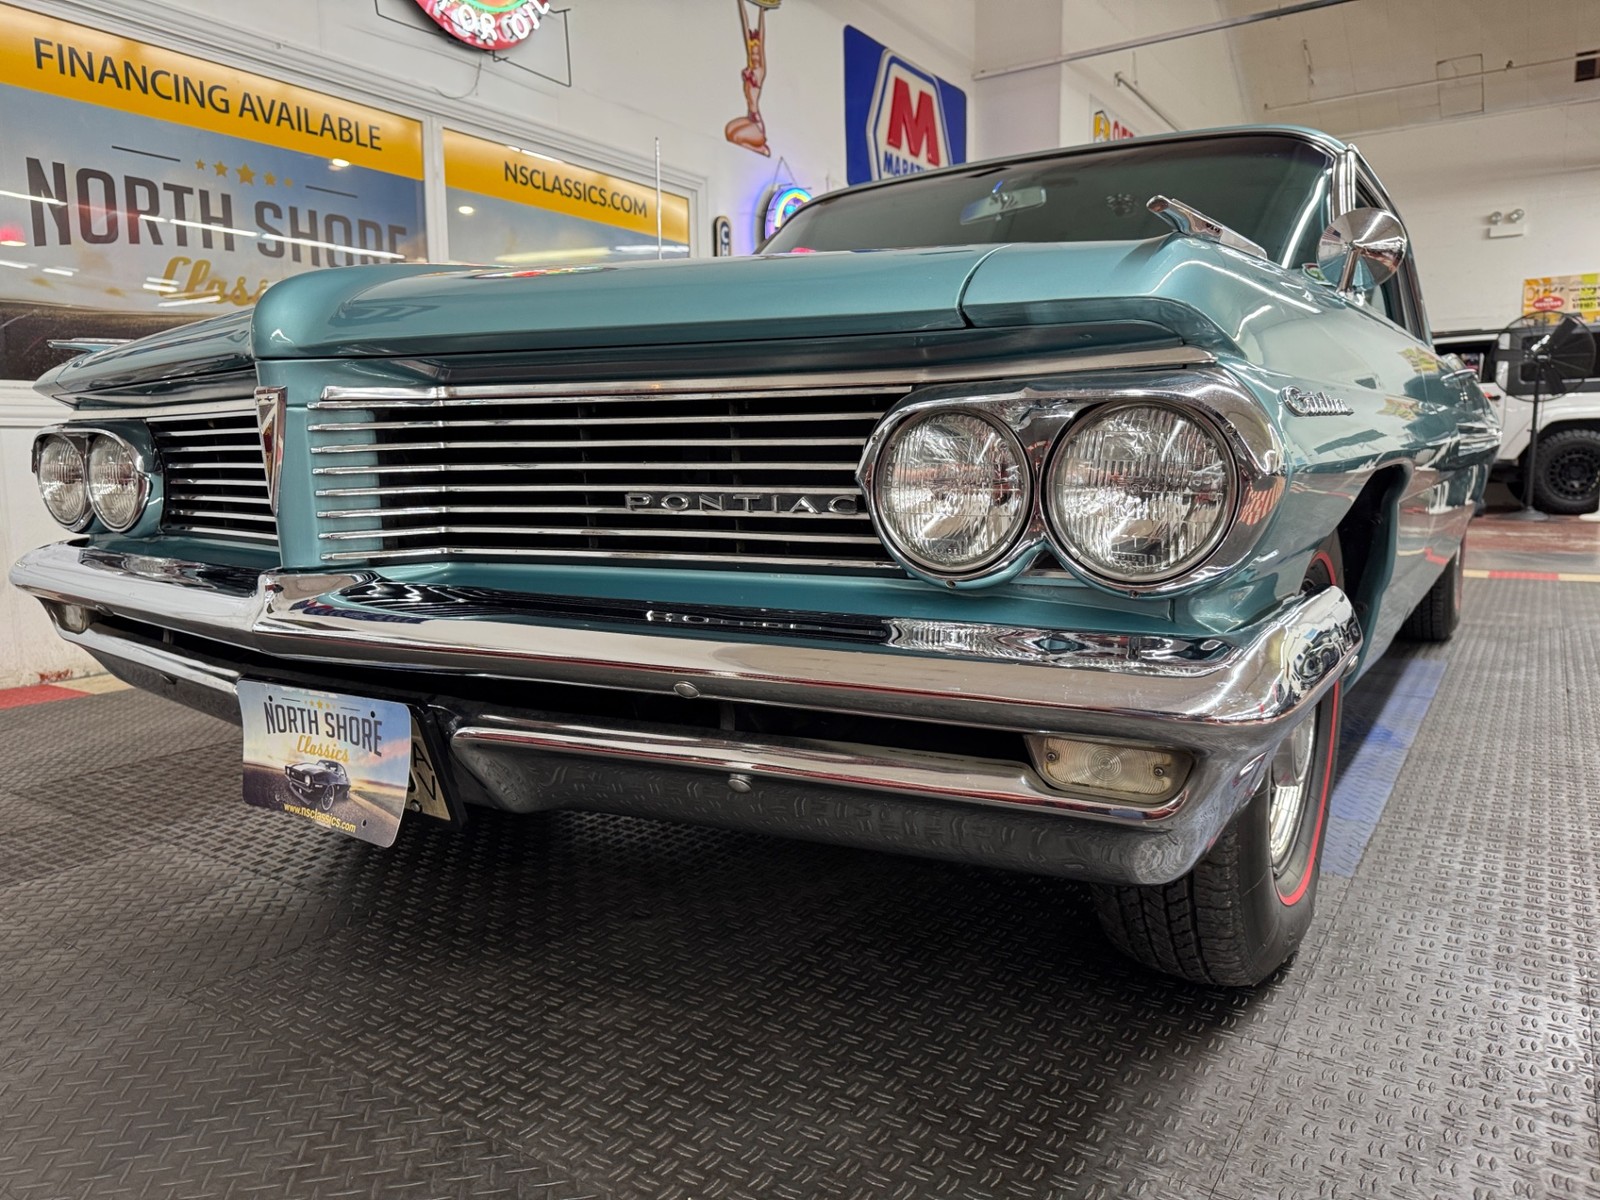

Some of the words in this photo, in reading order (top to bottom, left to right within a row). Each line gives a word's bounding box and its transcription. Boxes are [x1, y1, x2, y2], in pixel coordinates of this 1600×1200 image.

[33, 37, 230, 114] FINANCING
[238, 92, 383, 152] AVAILABLE
[887, 76, 940, 168] M
[26, 157, 236, 253] NORTH
[503, 161, 648, 219] NSCLASSICS.COM
[624, 493, 858, 515] PONTIAC
[263, 701, 319, 736] NORTH
[324, 711, 383, 757] SHORE
[296, 734, 350, 763] Classics
[283, 802, 357, 834] www.nsclassics.com
